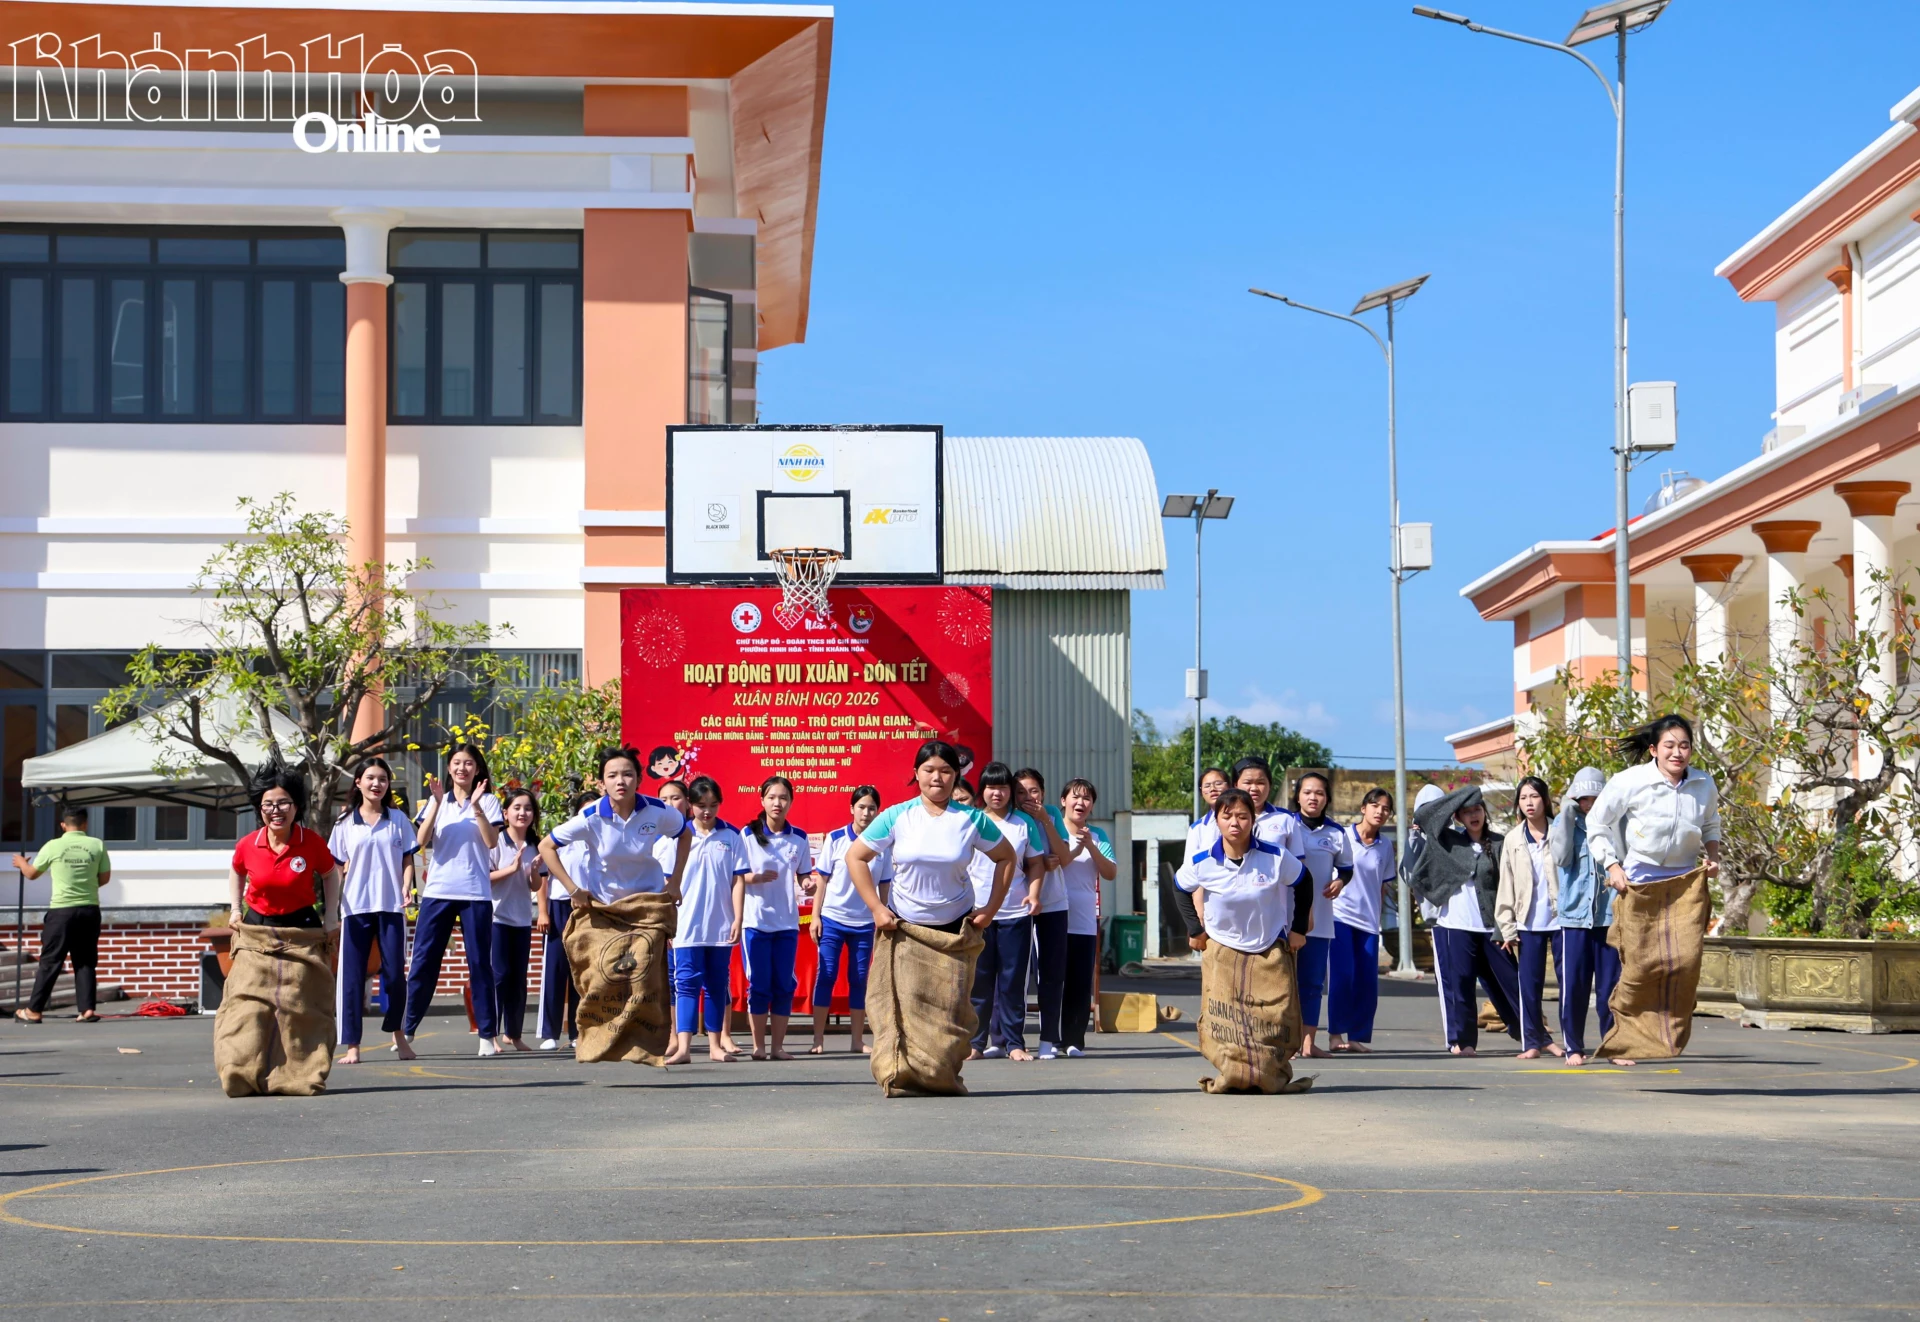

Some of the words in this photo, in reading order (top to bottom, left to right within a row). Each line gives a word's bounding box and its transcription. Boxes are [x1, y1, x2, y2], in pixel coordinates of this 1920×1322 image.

[778, 458, 802, 466] NINH
[804, 456, 825, 466] HÒA
[863, 508, 892, 524] AK
[889, 513, 917, 525] pro
[735, 637, 751, 645] CHỮ
[752, 637, 769, 646] THẬP
[684, 664, 724, 687] HOẠT
[728, 660, 771, 687] ĐỘNG
[776, 664, 801, 683] VUI
[806, 660, 848, 683] XUÂN
[864, 660, 897, 683] ĐÓN
[901, 657, 927, 682] TẾT
[733, 690, 772, 706] XUÂN
[775, 690, 809, 707] BÍNH
[813, 692, 842, 708] NGỌ
[845, 692, 879, 705] 2026
[701, 714, 721, 727] CÁC
[725, 713, 746, 727] GIẢI
[749, 713, 768, 727] THỂ
[771, 716, 797, 727] THAO
[808, 714, 827, 727] TRÒ
[831, 715, 855, 727] CHƠI
[858, 714, 880, 726] DÂN
[883, 716, 911, 727] GIAN:
[792, 731, 810, 740] XUÂN
[858, 730, 877, 740] NHÂN
[751, 744, 769, 754] NHẢY
[770, 745, 784, 754] BAO
[829, 745, 845, 754] NAM
[851, 744, 861, 754] NỮ
[761, 757, 775, 767] KÉO
[776, 758, 785, 767] CO
[819, 758, 835, 767] NAM
[841, 757, 852, 767] NỮ
[789, 769, 802, 780] LỘC
[819, 769, 838, 779] XUÂN
[738, 785, 756, 793] Ninh
[795, 785, 805, 793] 29
[806, 785, 827, 795] tháng
[829, 785, 838, 793] 01
[839, 785, 855, 793] năm
[1575, 780, 1604, 793] ELINE
[1208, 998, 1235, 1021] GHANA
